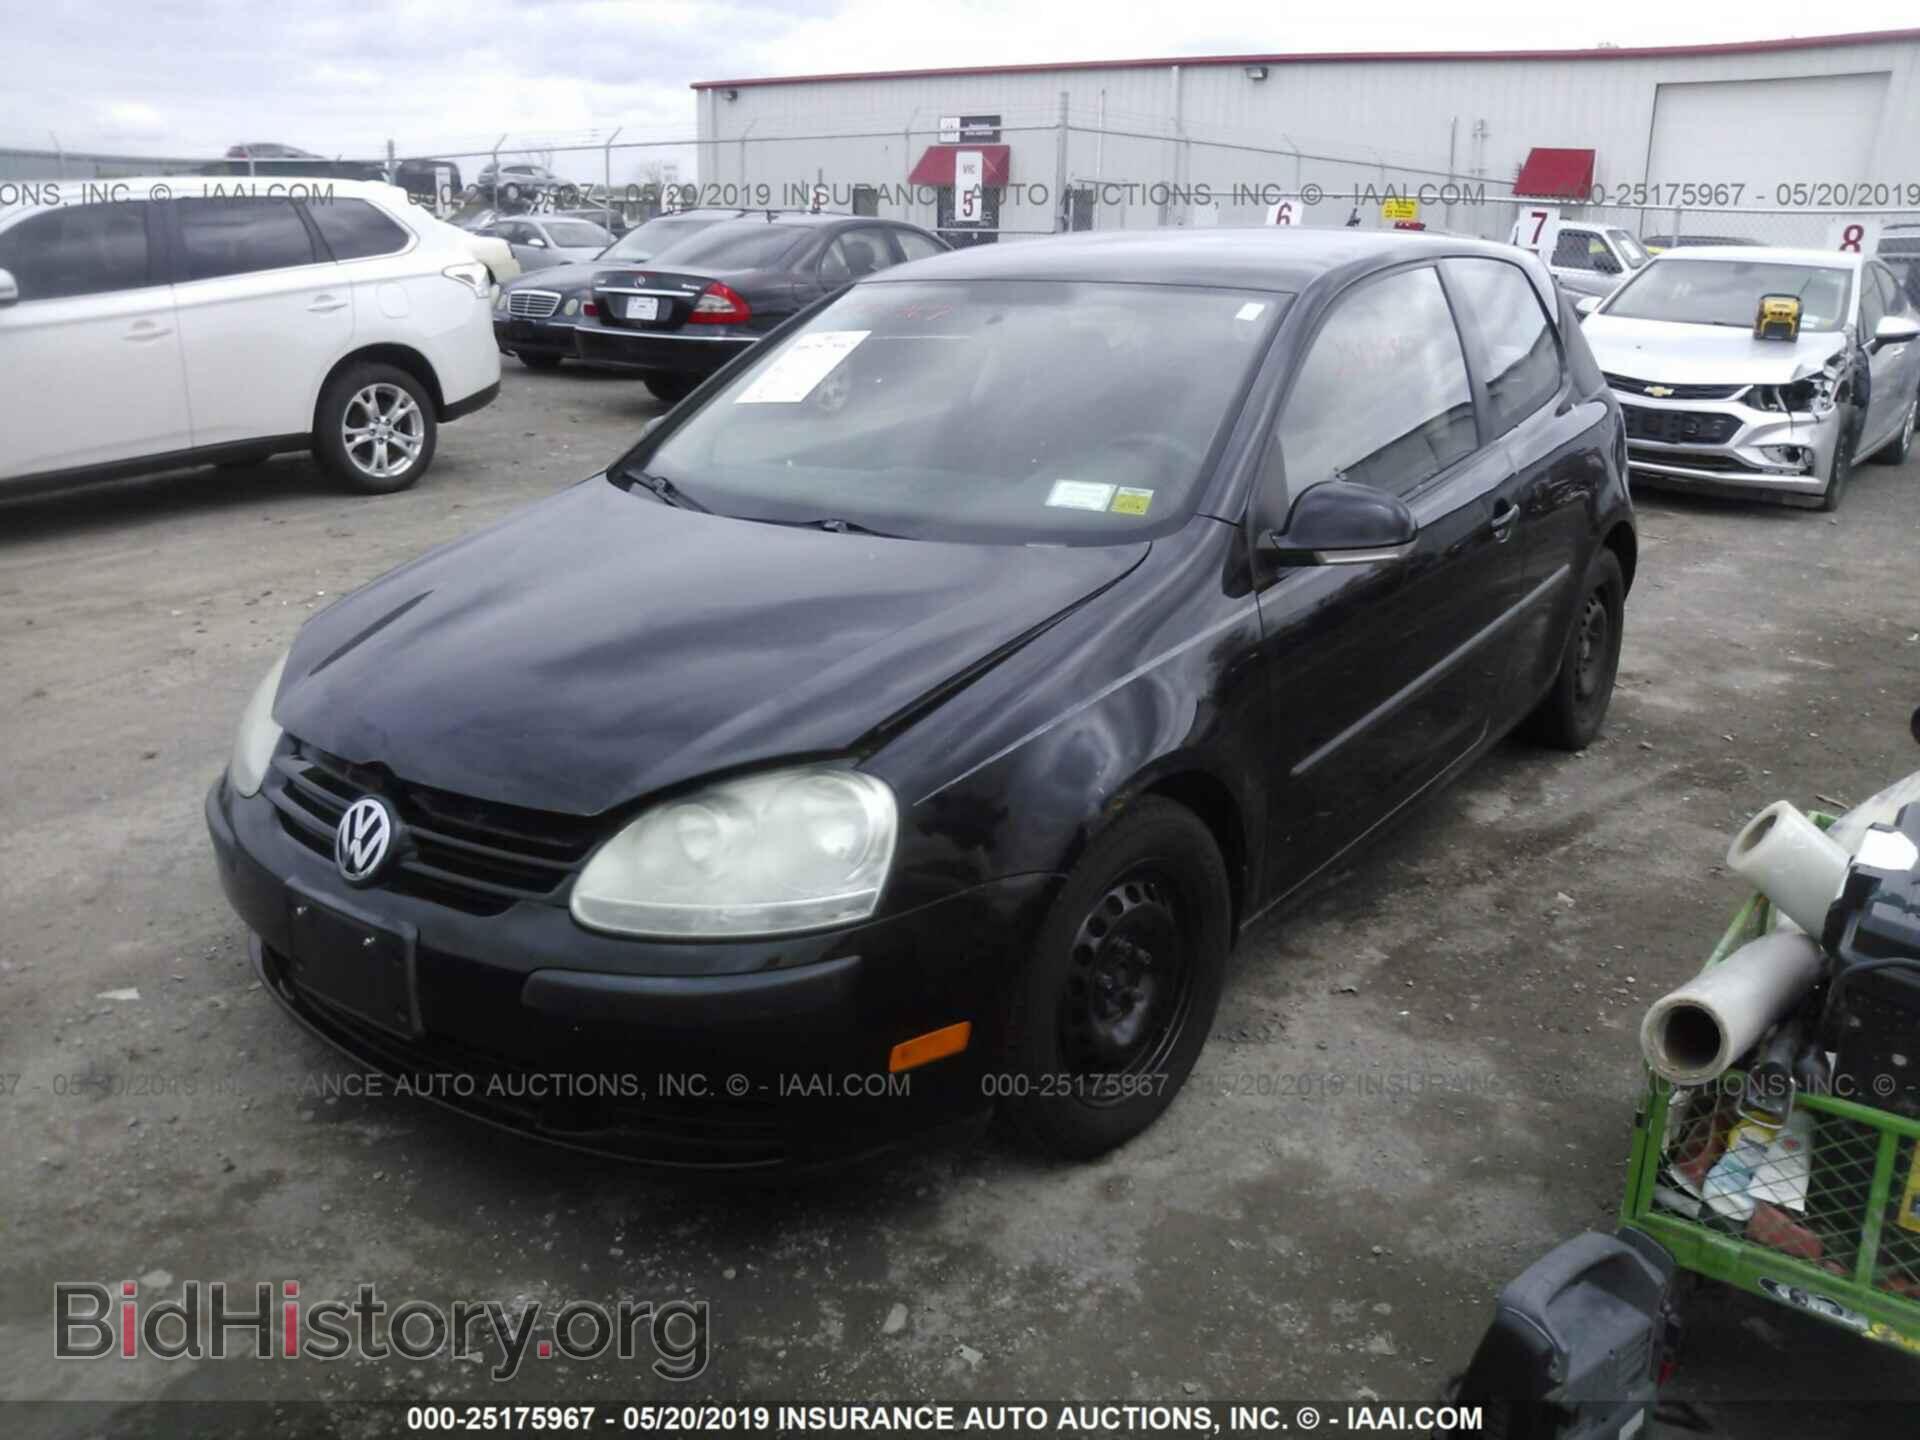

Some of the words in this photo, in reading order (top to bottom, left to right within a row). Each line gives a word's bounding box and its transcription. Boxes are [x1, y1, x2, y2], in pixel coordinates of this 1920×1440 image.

[962, 189, 974, 217] 5
[1275, 202, 1292, 225] 6
[1531, 212, 1548, 245] 7
[1839, 224, 1865, 253] 8
